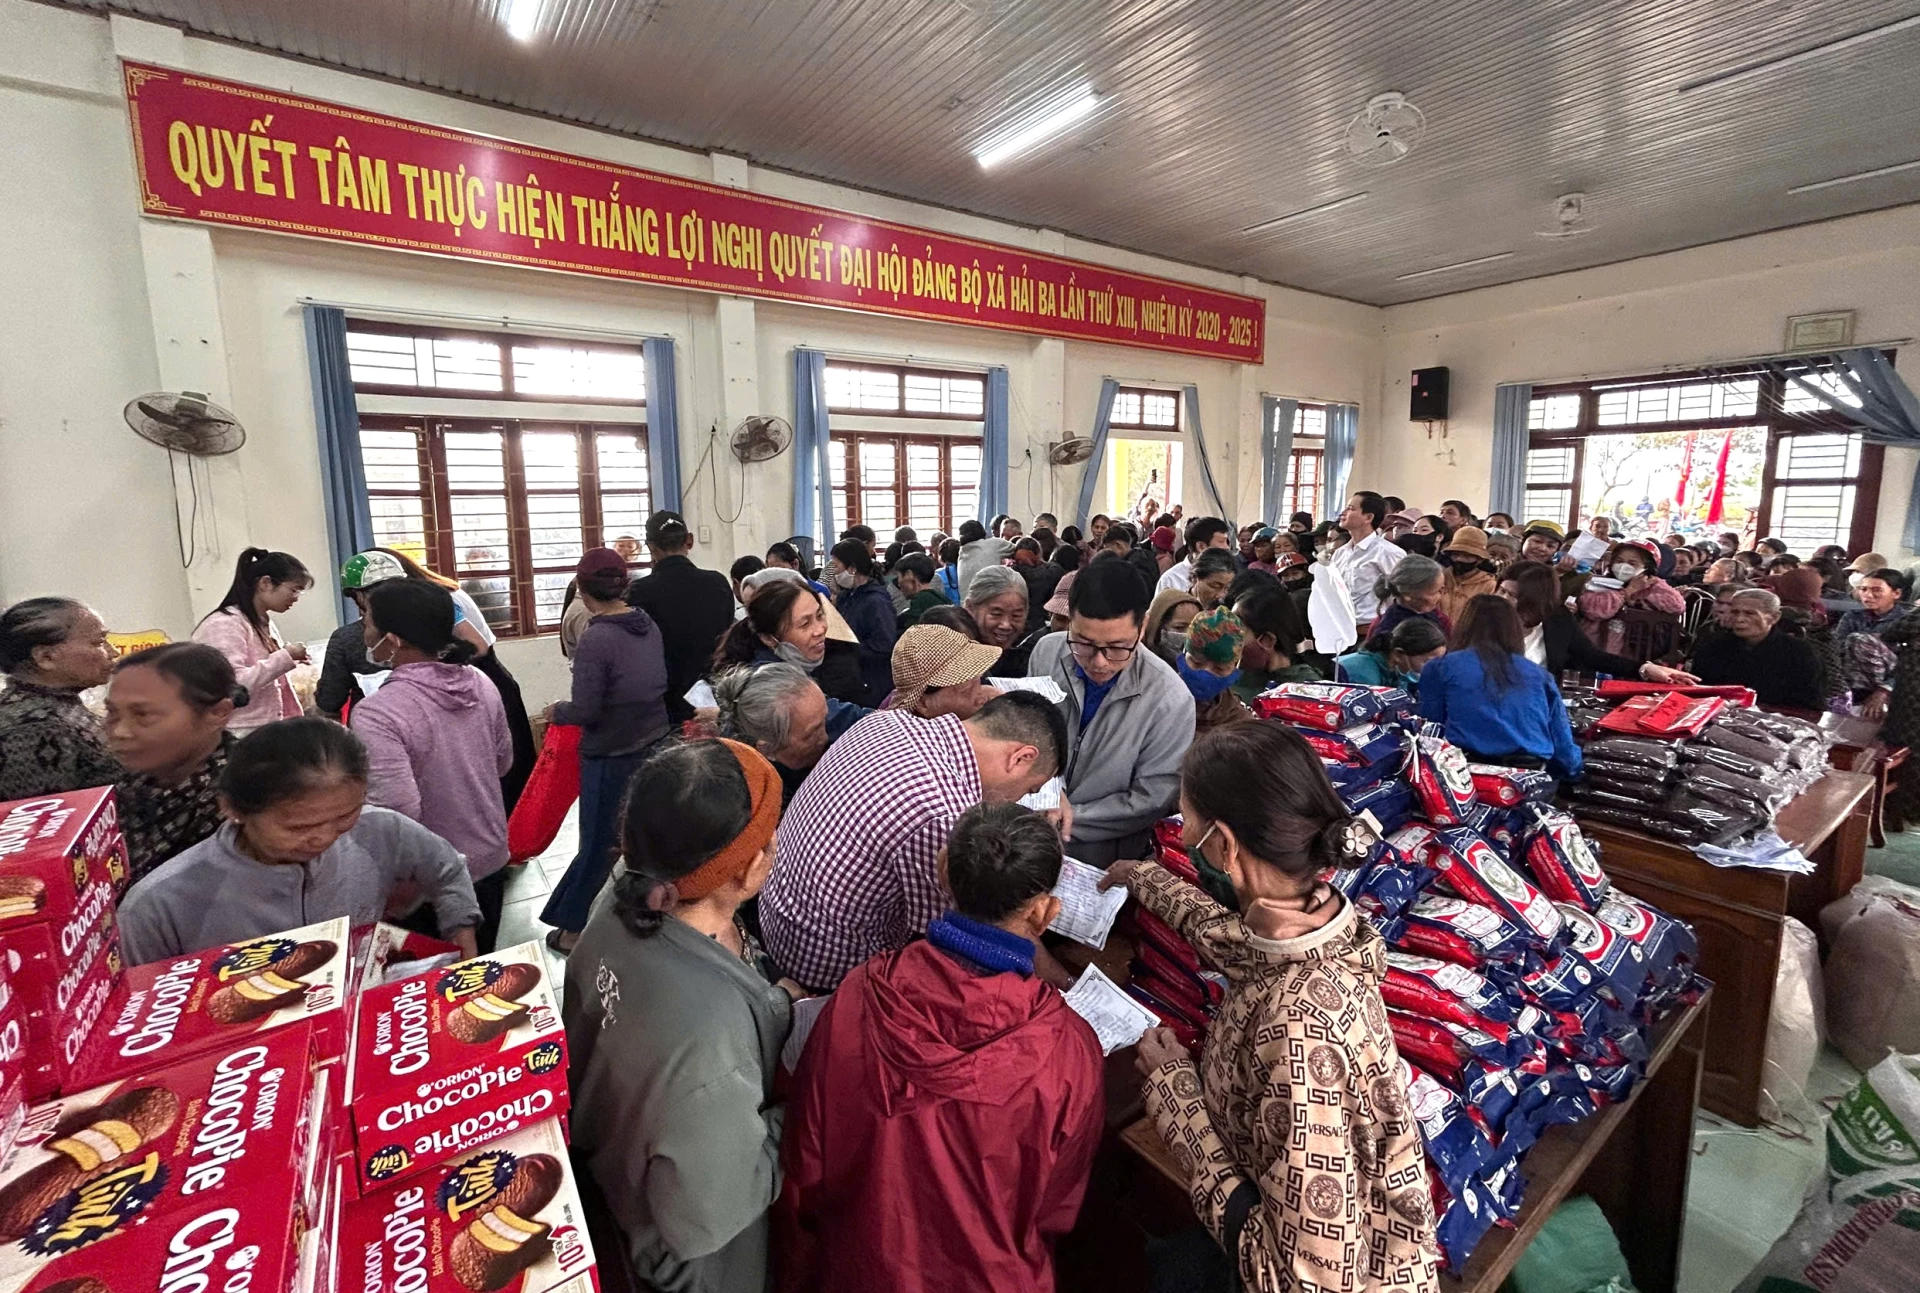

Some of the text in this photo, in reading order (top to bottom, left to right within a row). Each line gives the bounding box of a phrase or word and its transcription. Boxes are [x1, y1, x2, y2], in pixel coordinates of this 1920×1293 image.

[168, 115, 296, 199] QUYẾT
[309, 135, 392, 215] TÂM
[398, 163, 487, 236] THỰC
[496, 173, 566, 248] HIỆN
[571, 181, 660, 257] THẮNG
[666, 211, 705, 270] LỢI
[711, 223, 764, 281] NGHỊ
[769, 222, 833, 283] QUYẾT
[840, 244, 872, 296] ĐẠI
[877, 243, 907, 301] HỘI
[912, 245, 957, 303] ĐẢNG
[961, 259, 982, 314] BỘ
[986, 264, 1006, 310] XÃ
[1010, 264, 1034, 314] HẢI
[1038, 281, 1056, 317] BA
[1060, 272, 1085, 322] LẦN
[1088, 284, 1114, 326] THỨ
[1116, 295, 1138, 336] XIII,
[1141, 295, 1177, 340] NHIỆM
[1179, 300, 1194, 338] KỲ
[1195, 310, 1220, 342] 2020
[1228, 316, 1251, 347] 2025
[62, 881, 112, 957] ChocoPie
[57, 931, 101, 1010] ChocoPie
[65, 979, 111, 1065] ChocoPie
[119, 989, 149, 1025] ORION
[119, 958, 202, 1057] ChocoPie
[376, 1010, 392, 1044] ORION
[389, 980, 430, 1076] ChocoPie
[252, 1084, 279, 1130] ORION
[377, 1065, 523, 1132] ChocoPie
[433, 1066, 483, 1091] ORION
[181, 1045, 269, 1195] ChocoPie
[414, 1088, 554, 1154] ChocoPie
[458, 1125, 505, 1151] ORION
[1308, 1123, 1344, 1138] VERSACE
[560, 1232, 586, 1273] 10%
[1299, 1247, 1341, 1272] VERSACE
